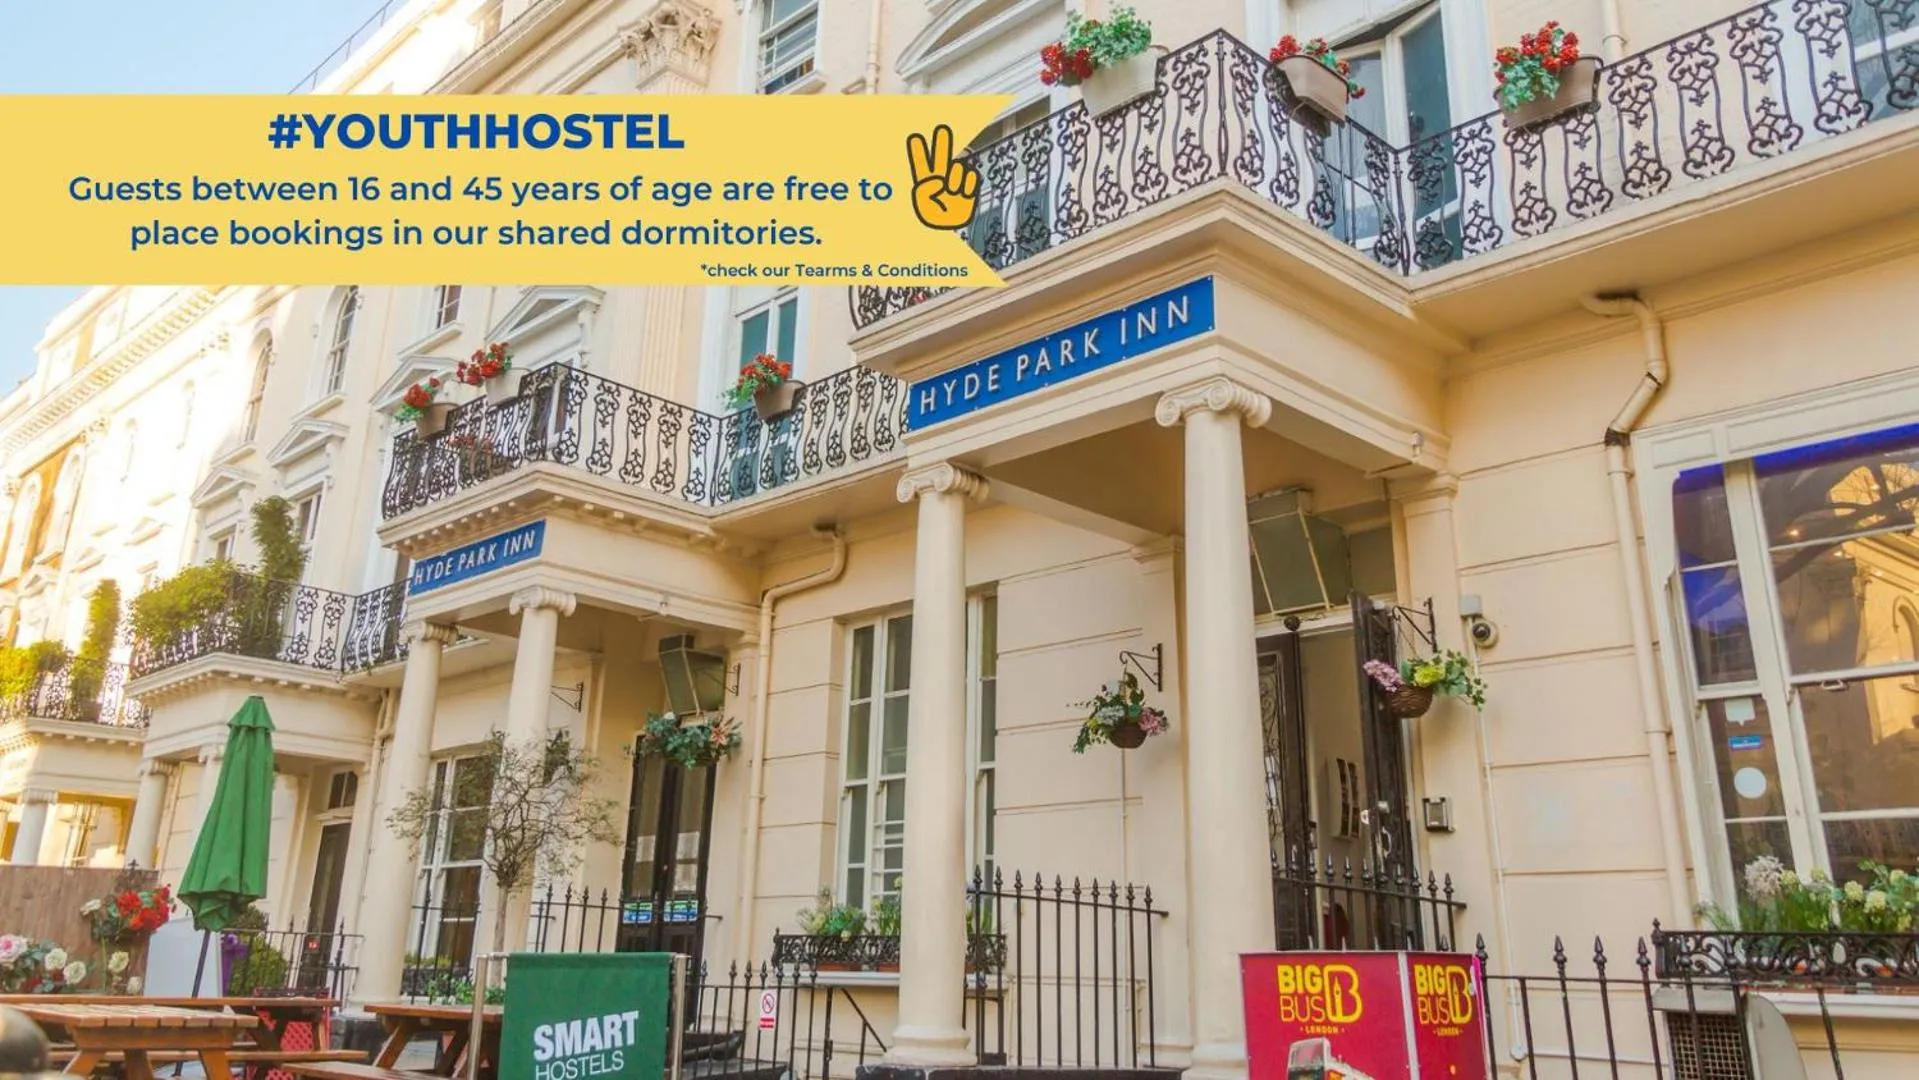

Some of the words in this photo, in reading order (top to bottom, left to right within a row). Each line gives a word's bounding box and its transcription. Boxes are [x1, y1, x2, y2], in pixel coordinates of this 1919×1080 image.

[919, 364, 1000, 415] HYDE
[1016, 327, 1101, 382] PARK
[1120, 295, 1190, 346] INN
[414, 556, 453, 586] HYDE
[457, 542, 498, 572] PARK
[503, 529, 536, 557] INN
[1277, 964, 1323, 995] BIG
[1414, 964, 1446, 995] BIG
[1280, 994, 1326, 1024] BUS
[1418, 996, 1450, 1025] BUS
[533, 1010, 640, 1062] SMART
[534, 1050, 625, 1080] HOSTELS
